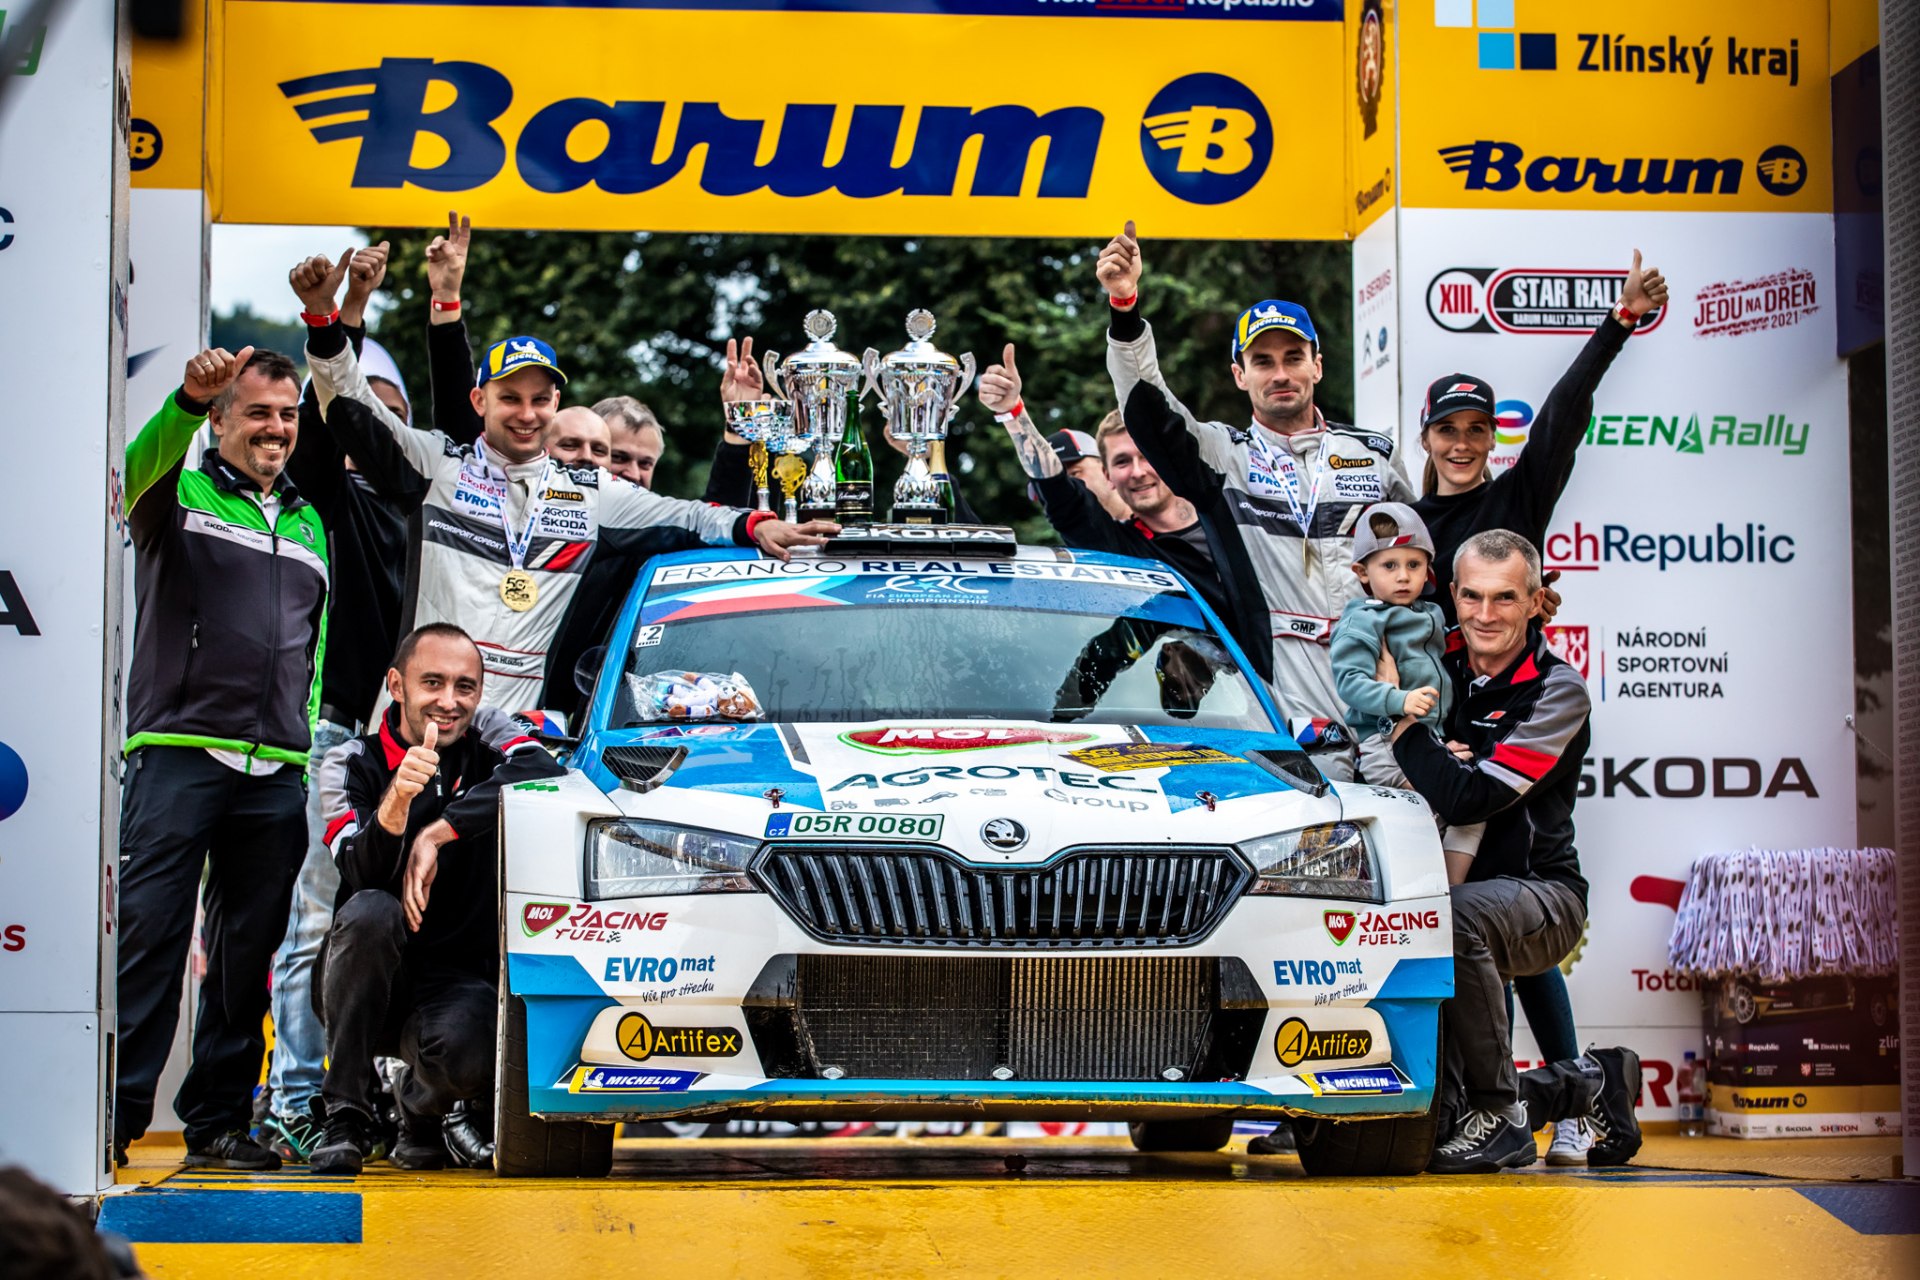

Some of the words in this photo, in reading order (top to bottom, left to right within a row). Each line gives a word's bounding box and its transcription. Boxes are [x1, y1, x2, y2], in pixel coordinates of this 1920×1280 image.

[1577, 33, 1713, 84] Zlínský
[1727, 36, 1799, 87] kraj
[277, 57, 1105, 198] Barum
[1437, 140, 1744, 195] Barum
[1439, 283, 1480, 315] XIII.
[1512, 277, 1569, 308] STAR
[1574, 278, 1622, 309] RALL
[1542, 313, 1566, 325] RALLY
[1694, 295, 1743, 328] JEDU
[1745, 297, 1762, 313] NA
[1770, 310, 1799, 329] 2021
[1248, 316, 1296, 335] MICHELIN
[1708, 414, 1810, 456] Rally
[1334, 473, 1380, 483] AGROTEC
[1335, 481, 1381, 494] ŠKODA
[541, 506, 589, 520] AGROTEC
[428, 519, 474, 539] MOTORSPORT
[540, 516, 587, 531] ŠKODA
[543, 527, 565, 535] RALLY
[660, 560, 846, 583] FRANCO
[861, 560, 963, 575] REAL
[995, 562, 1174, 588] ESTATES
[1290, 622, 1316, 634] OMP
[1616, 626, 1707, 648] NÁRODNÍ
[1617, 652, 1729, 673] SPORTOVNÍ
[1617, 682, 1725, 698] AGENTURA
[877, 727, 1015, 744] MOL
[826, 765, 1158, 794] AGROTEC
[1043, 787, 1150, 813] Group
[769, 827, 786, 837] CZ
[793, 814, 853, 833] 05R
[857, 815, 937, 837] 0080
[527, 906, 554, 920] MOL
[568, 903, 669, 931] RACING
[1327, 914, 1348, 929] MOL
[1356, 910, 1439, 933] RACING
[1358, 933, 1398, 946] FUEL
[660, 988, 677, 1004] pro
[1328, 990, 1342, 1006] pro
[653, 1029, 738, 1053] Artifex
[1307, 1032, 1369, 1057] Artifex
[604, 1075, 682, 1086] MICHELIN
[1333, 1077, 1390, 1089] MICHELIN
